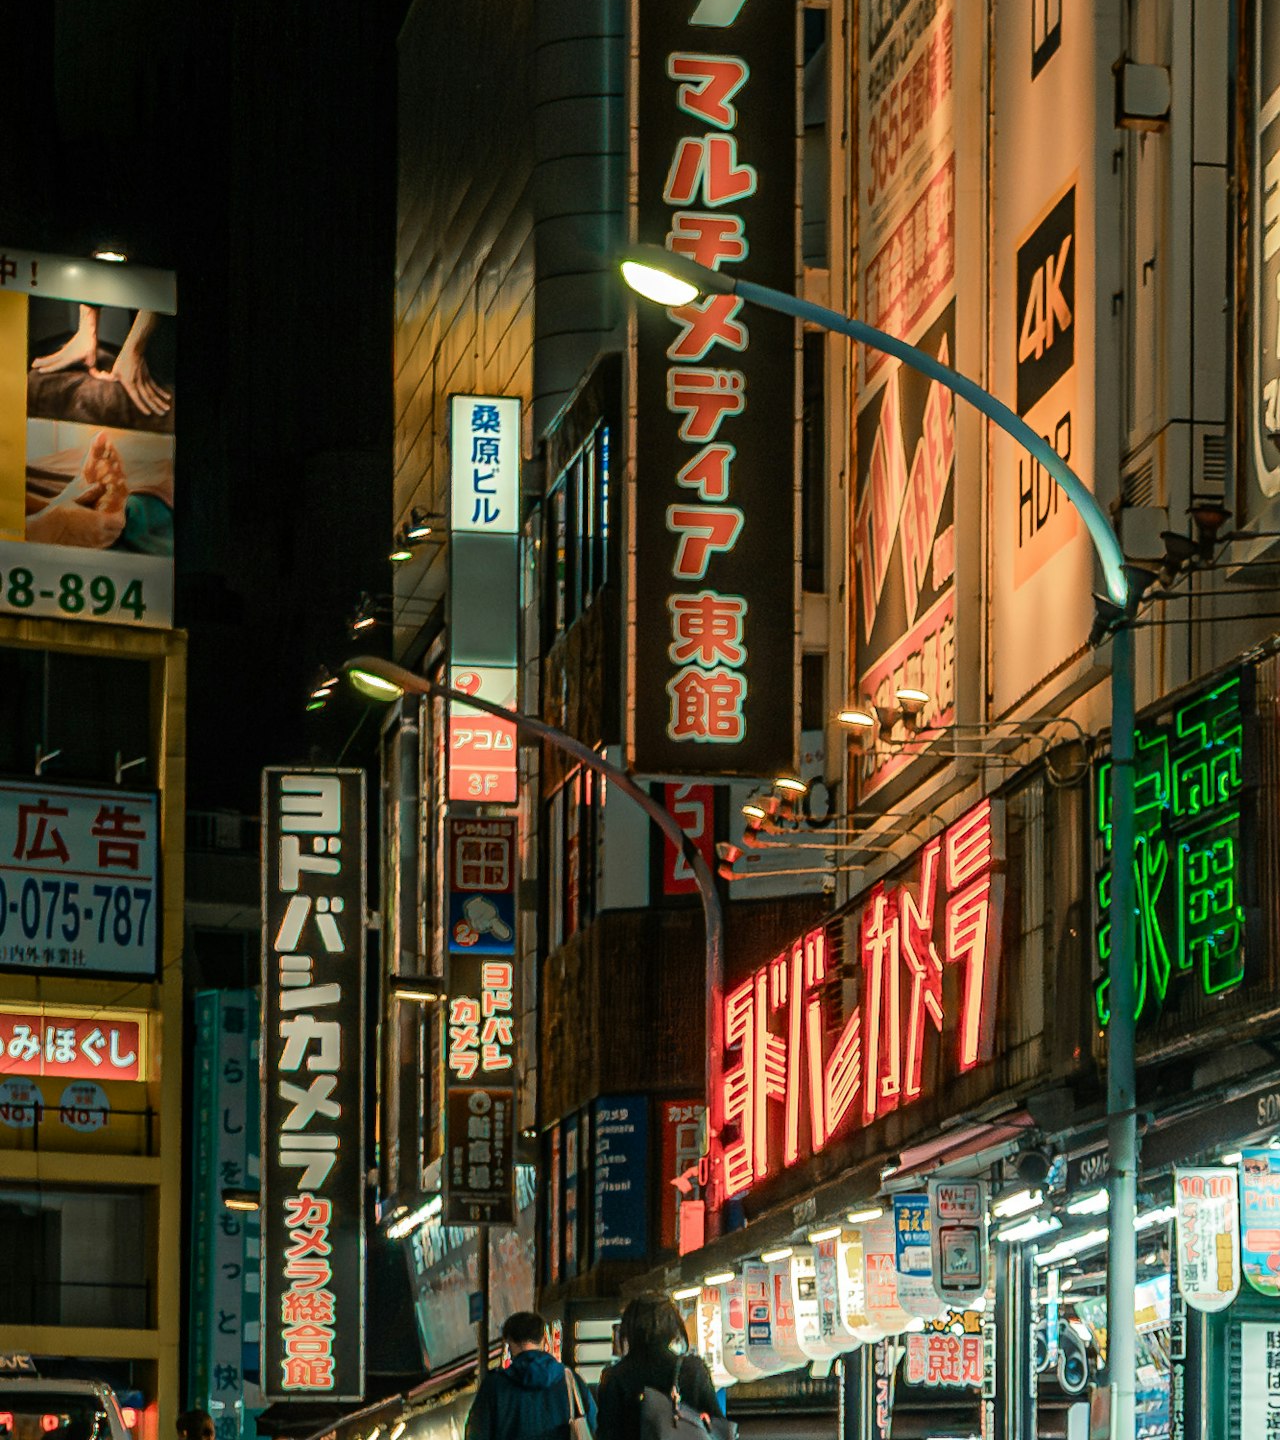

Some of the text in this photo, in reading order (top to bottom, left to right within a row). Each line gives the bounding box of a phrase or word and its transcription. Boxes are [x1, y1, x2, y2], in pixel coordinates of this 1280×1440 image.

[1018, 233, 1074, 362] 4K
[470, 404, 501, 525] 桑原ビル
[1018, 410, 1072, 549] HDR
[0, 566, 148, 622] 8-894
[452, 728, 513, 751] アコム
[467, 773, 499, 796] 3F
[12, 798, 147, 871] 広告
[0, 877, 152, 948] -075-787
[273, 774, 346, 1191] ヨドバシカメラ
[481, 961, 513, 1072] ヨドバシ
[718, 795, 994, 1197] ヨドバシカメラ
[0, 1024, 137, 1069] みほぐし
[449, 996, 480, 1080] カメラ
[939, 1185, 977, 1203] Wi-Fi
[281, 1192, 336, 1391] カメラ総合館
